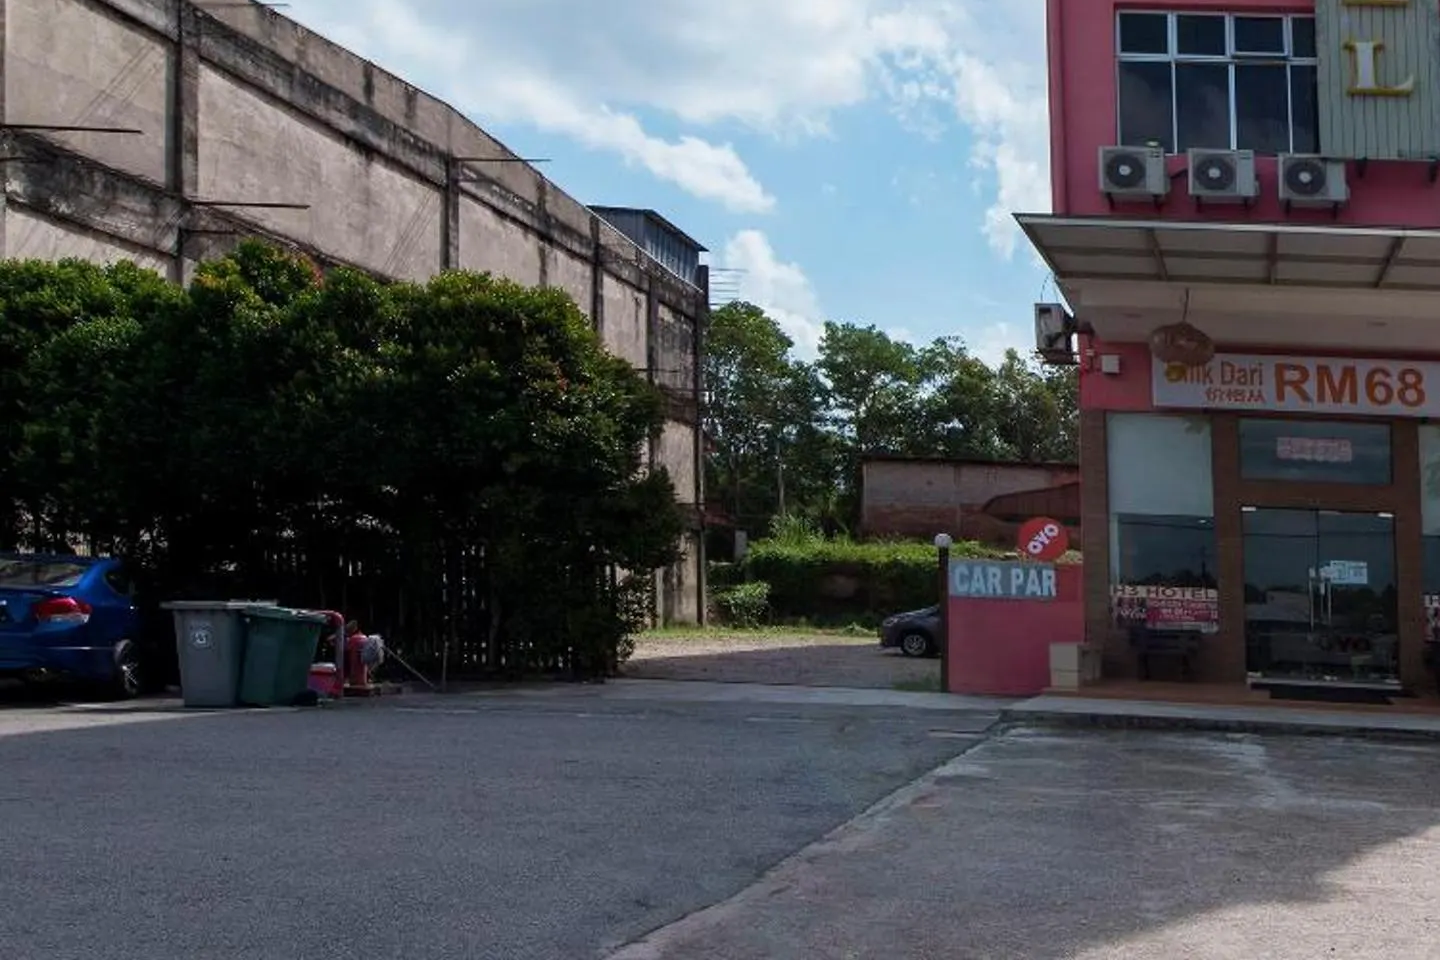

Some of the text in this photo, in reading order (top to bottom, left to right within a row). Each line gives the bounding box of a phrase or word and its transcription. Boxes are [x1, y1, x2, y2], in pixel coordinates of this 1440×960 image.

[1220, 360, 1264, 386] Dari
[1274, 362, 1426, 408] RM68
[1027, 523, 1059, 554] OYO
[954, 563, 1057, 597] CAR PAR
[1146, 587, 1218, 602] HOTEL
